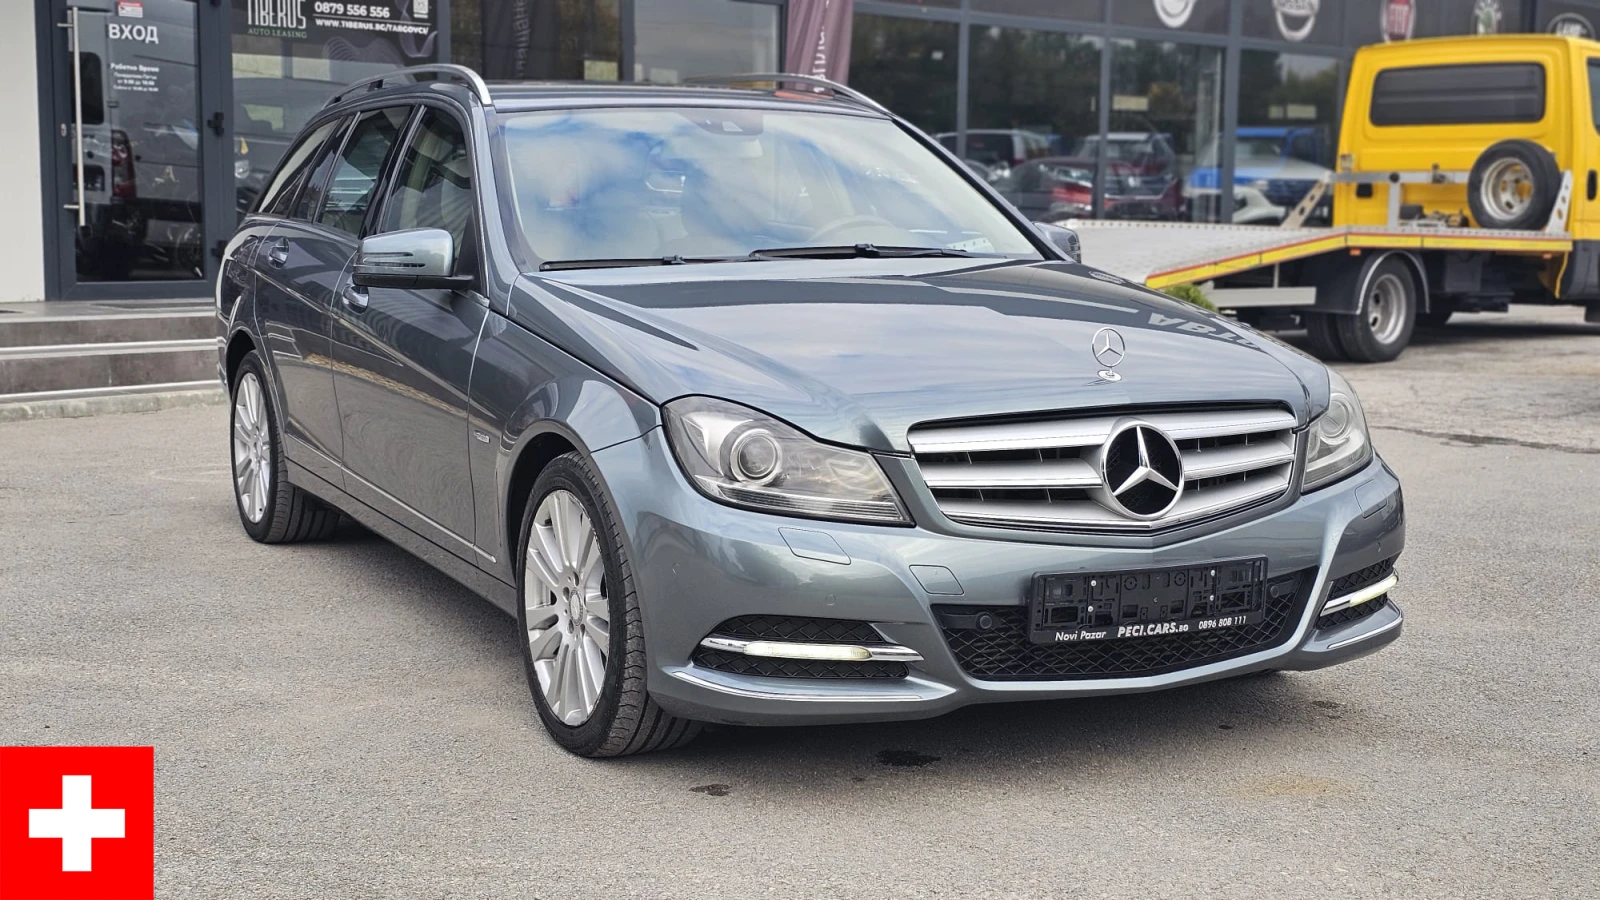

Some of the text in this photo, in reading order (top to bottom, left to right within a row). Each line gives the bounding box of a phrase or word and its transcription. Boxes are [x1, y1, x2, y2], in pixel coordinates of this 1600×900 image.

[314, 1, 390, 18] 0879 556 556
[109, 23, 159, 44] ВХОД
[247, 28, 307, 39] AUTO LEASING
[1055, 630, 1079, 641] Novi
[1080, 630, 1107, 640] Pazar
[1198, 619, 1217, 630] 0896
[1218, 617, 1232, 627] 808
[1234, 615, 1247, 625] 111
